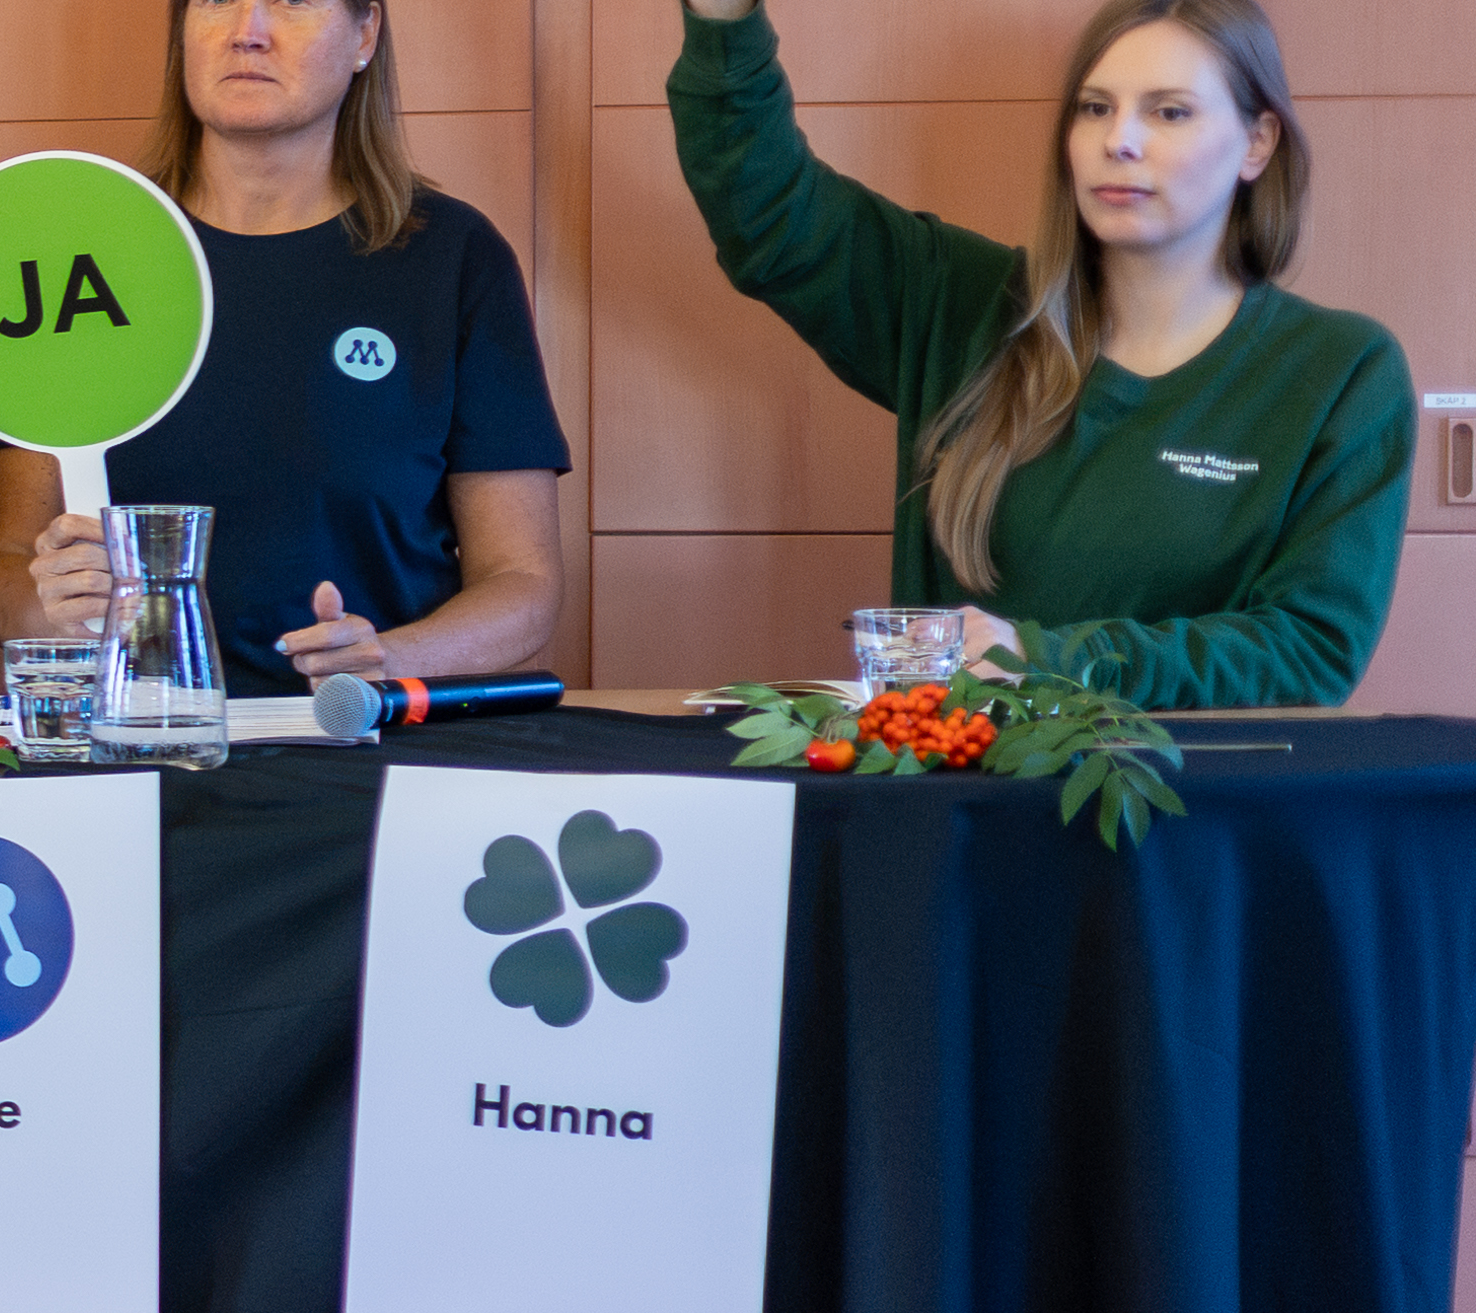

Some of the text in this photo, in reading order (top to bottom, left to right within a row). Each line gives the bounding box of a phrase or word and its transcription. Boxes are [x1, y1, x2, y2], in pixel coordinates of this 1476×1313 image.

[1161, 450, 1259, 471] Hanna Mattsson
[1179, 463, 1237, 482] Wagenius
[473, 1082, 653, 1141] Hanna
